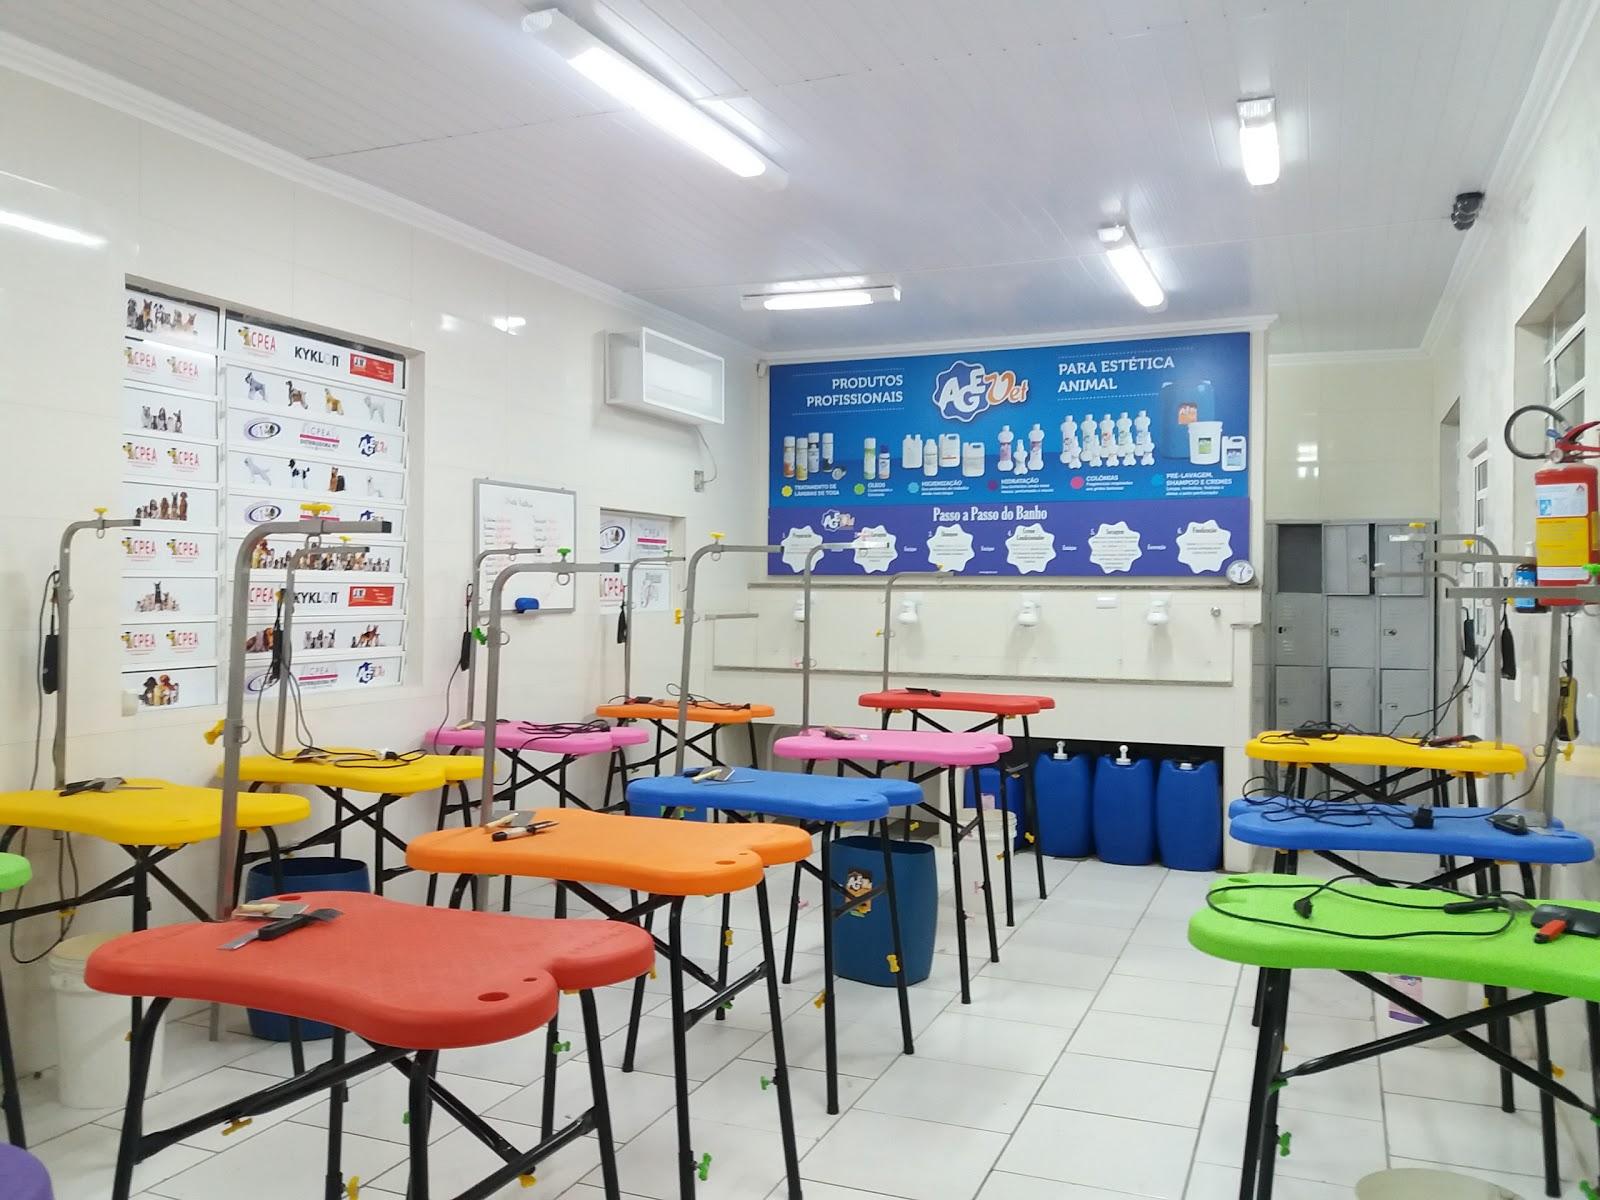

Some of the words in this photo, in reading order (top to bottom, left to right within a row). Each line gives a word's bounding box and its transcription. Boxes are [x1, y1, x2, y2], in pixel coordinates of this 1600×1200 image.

[251, 332, 276, 352] CPEA
[134, 351, 157, 368] CPEA
[1058, 362, 1097, 376] PARA
[1101, 356, 1175, 373] ESTÉTICA
[178, 360, 199, 377] CPEA
[832, 374, 904, 390] PRODUTOS
[1058, 378, 1118, 393] ANIMAL
[806, 390, 904, 407] PROFISSIONAIS
[135, 446, 158, 463] CPEA
[179, 451, 200, 467] CPEA
[933, 507, 960, 522] Passo
[962, 511, 969, 521] a
[970, 506, 998, 521] Passo
[1001, 506, 1014, 521] do
[1016, 505, 1048, 521] Banho
[133, 540, 156, 555] CPEA
[178, 542, 200, 556] CPEA
[133, 634, 156, 649] CPEA
[178, 632, 199, 647] CPEA
